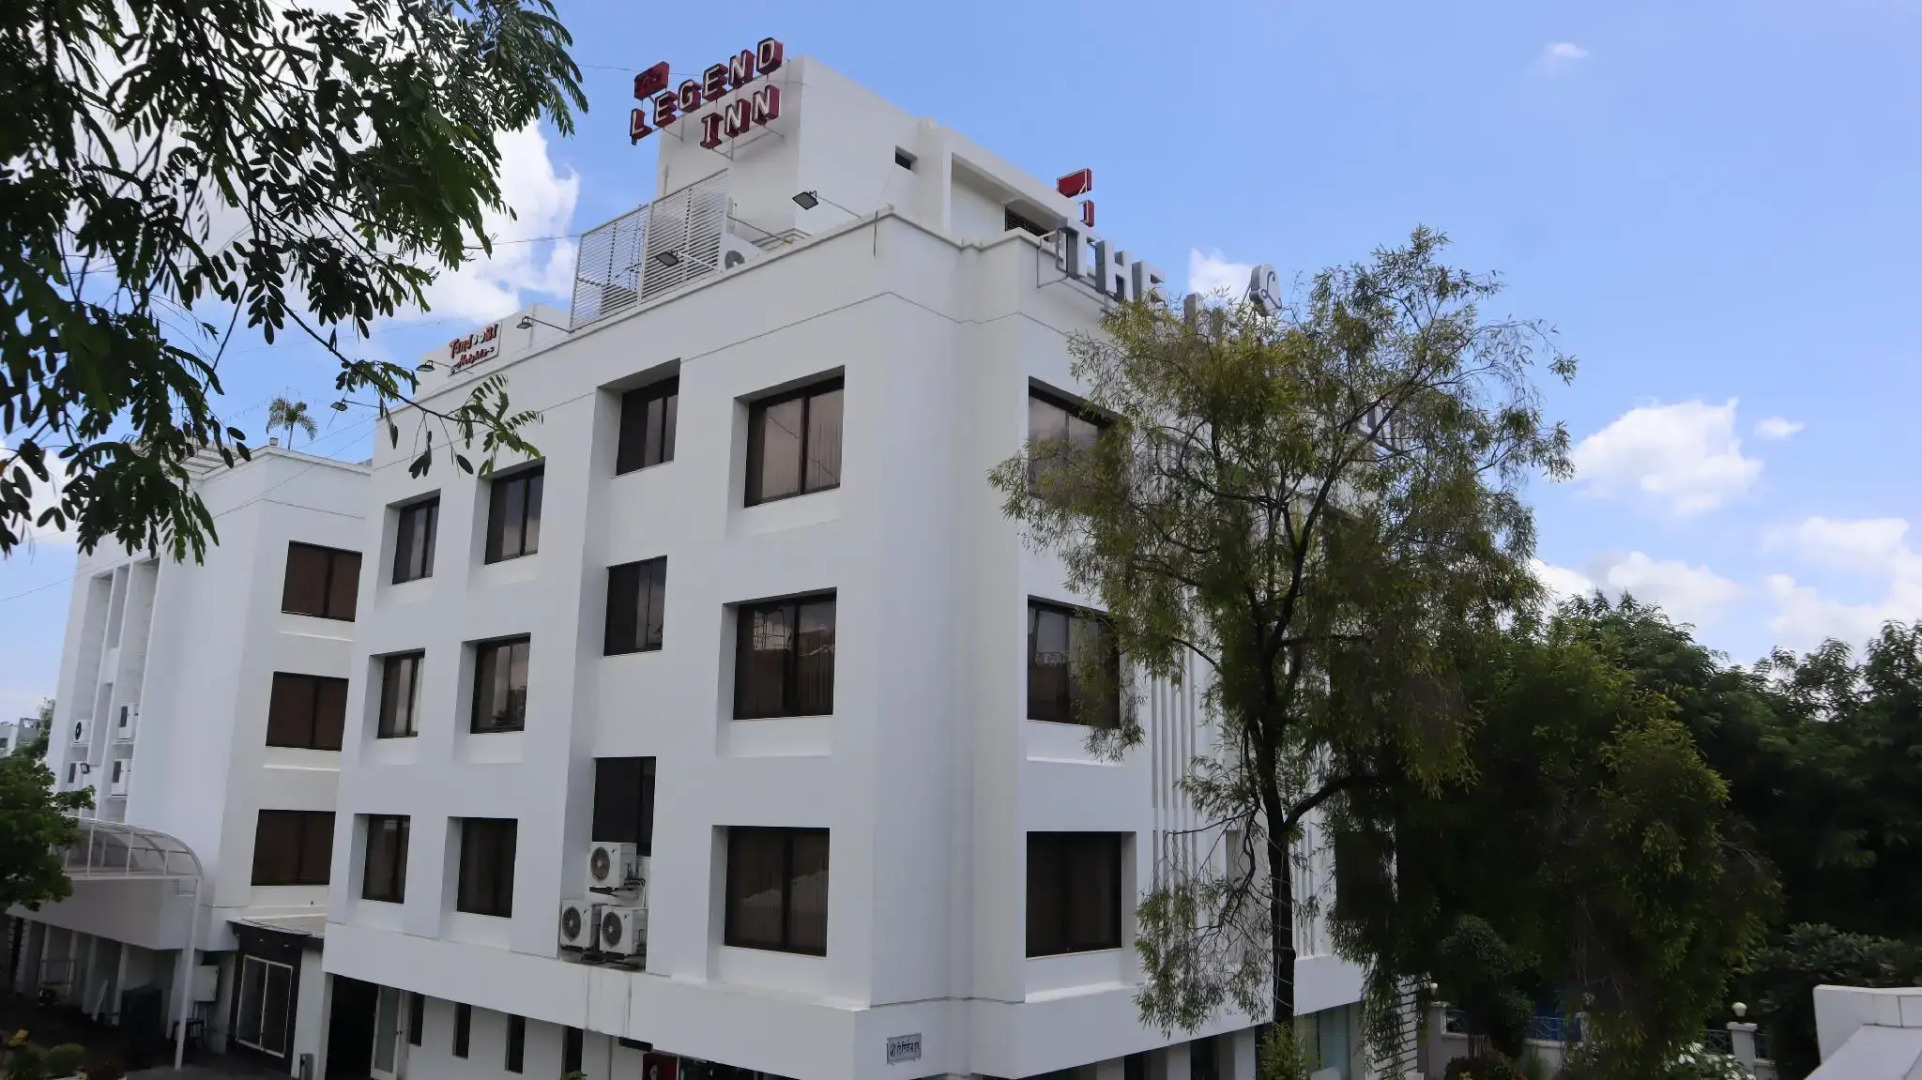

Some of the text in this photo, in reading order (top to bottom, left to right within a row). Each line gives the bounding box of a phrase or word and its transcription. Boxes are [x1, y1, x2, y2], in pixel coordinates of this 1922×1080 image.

[630, 37, 783, 140] LEGEND
[700, 84, 781, 149] INN
[1056, 217, 1167, 312] THE
